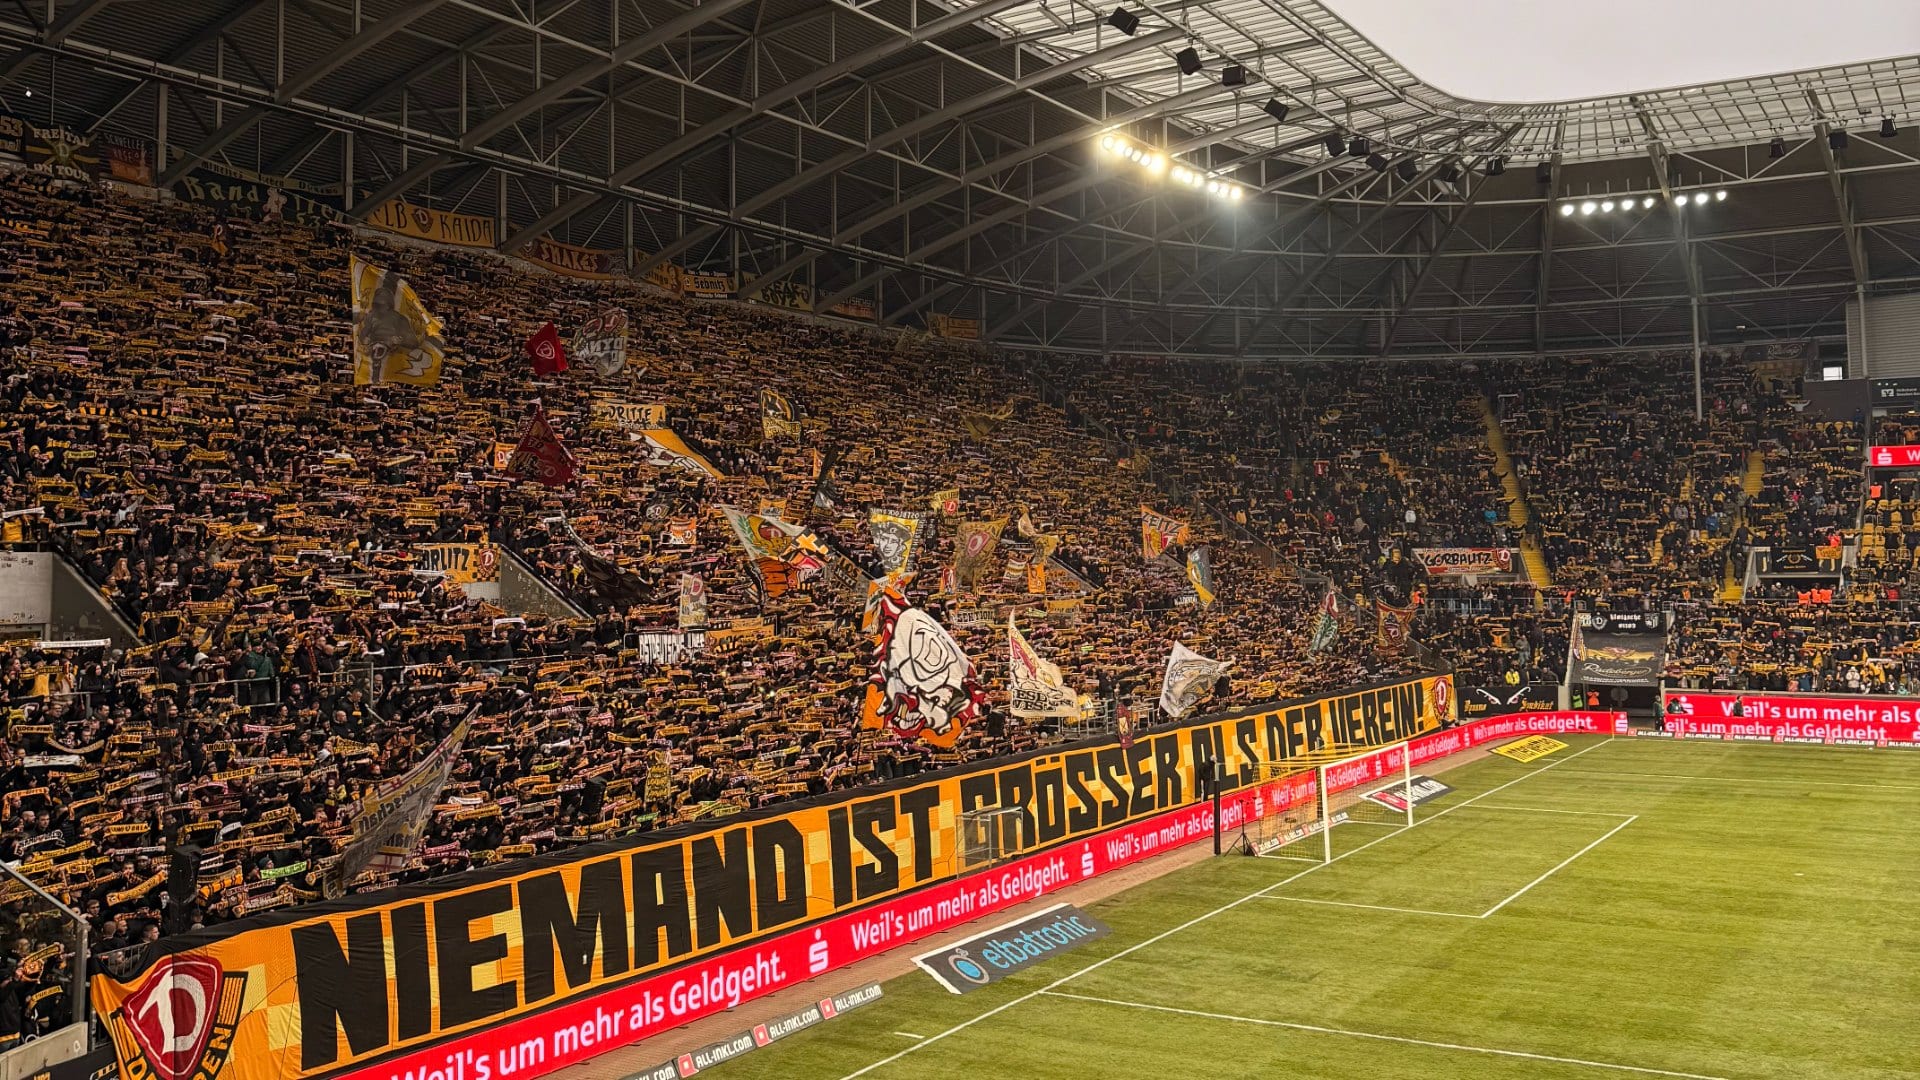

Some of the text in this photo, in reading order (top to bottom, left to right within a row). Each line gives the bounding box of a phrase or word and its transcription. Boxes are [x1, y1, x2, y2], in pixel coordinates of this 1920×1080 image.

[56, 165, 90, 184] TOUR
[440, 214, 493, 244] KAIDA
[1514, 718, 1526, 731] als
[1527, 714, 1598, 733] Geldgeht.
[1720, 700, 1912, 723] Weil's um mehr als
[1665, 718, 1698, 733] eil's
[1701, 722, 1726, 733] um
[1730, 721, 1773, 736] mehr
[1776, 722, 1799, 737] als
[1435, 733, 1462, 754] Geldgeht.
[1106, 833, 1141, 862] Weil's
[1141, 832, 1158, 851] um
[1160, 820, 1187, 846] mehr
[1187, 814, 1201, 836] als
[290, 819, 808, 1069] NIEMAND
[828, 785, 940, 908] IST
[960, 733, 1182, 867] GRÖSSER
[1191, 719, 1260, 799] ALS
[1265, 702, 1324, 763] DER
[1328, 681, 1425, 748] VEREIN!
[851, 855, 1070, 951] Weil's um mehr als Geldgeht.
[981, 913, 1097, 971] elbatronic
[499, 1036, 545, 1076] um
[553, 1006, 625, 1057] mehr
[628, 990, 665, 1031] als
[669, 950, 787, 1009] Geldgeht.
[836, 984, 882, 1012] ALL-INKL.COM
[769, 1007, 820, 1038] ALL-INKL.COM
[695, 1034, 753, 1067] ALL-INKL.COM
